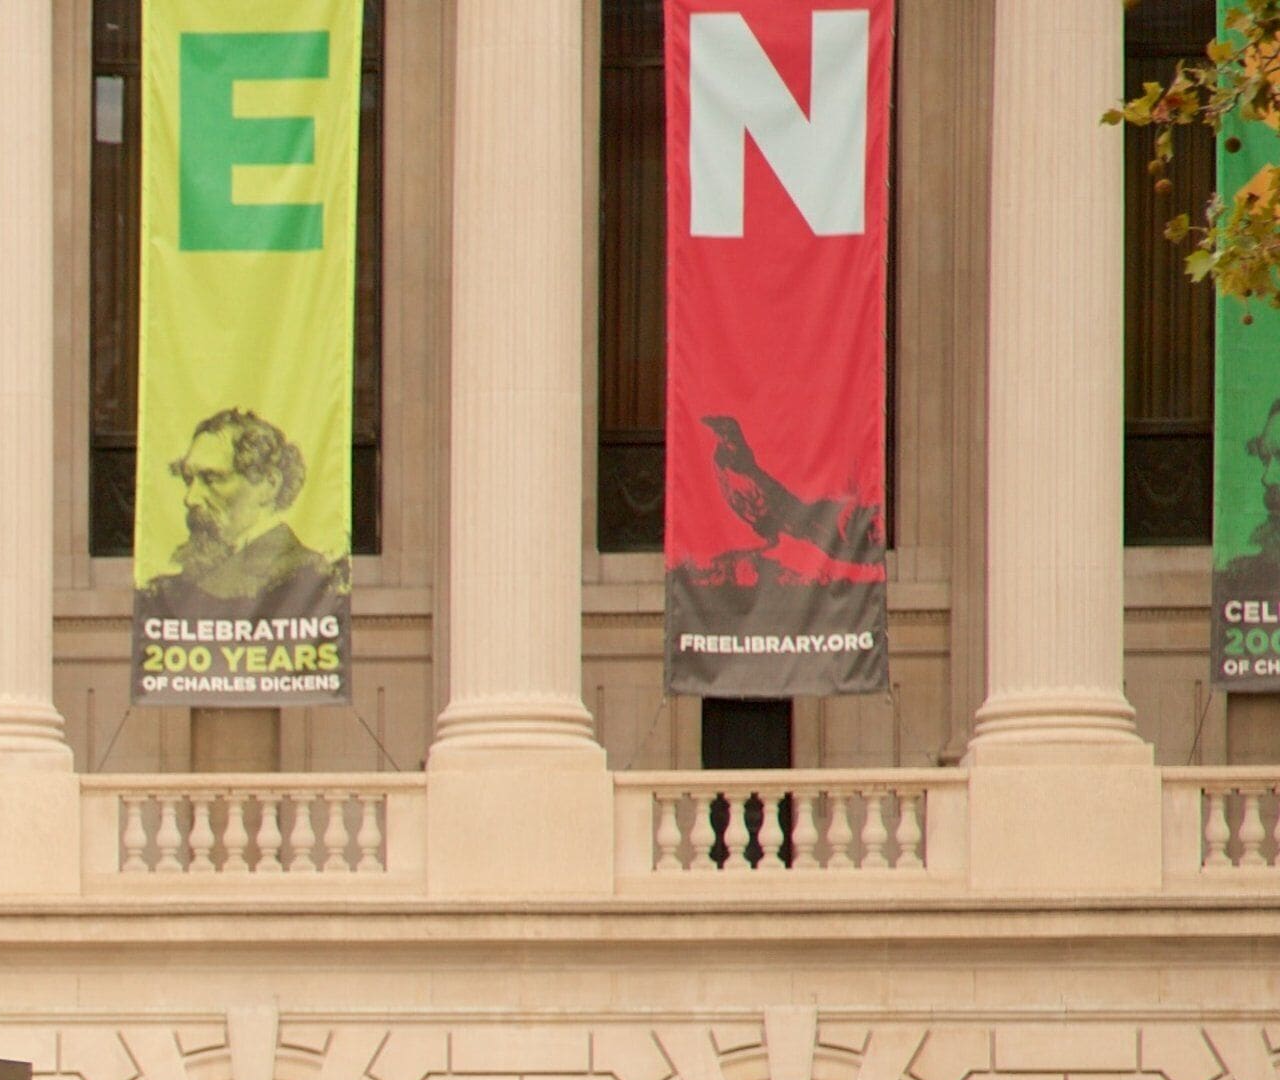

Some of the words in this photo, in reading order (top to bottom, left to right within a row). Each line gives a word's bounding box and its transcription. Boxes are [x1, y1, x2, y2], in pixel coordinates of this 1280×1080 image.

[689, 9, 871, 238] N
[179, 31, 330, 252] E
[1224, 600, 1280, 623] CEL
[144, 616, 339, 641] CELEBRATING
[679, 631, 874, 653] FREELIBRARY.ORG
[143, 645, 212, 672] 200
[221, 643, 339, 672] YEARS
[1224, 659, 1249, 675] OF
[142, 676, 169, 691] OF
[171, 676, 257, 692] CHARLES
[260, 675, 340, 691] DICKENS
